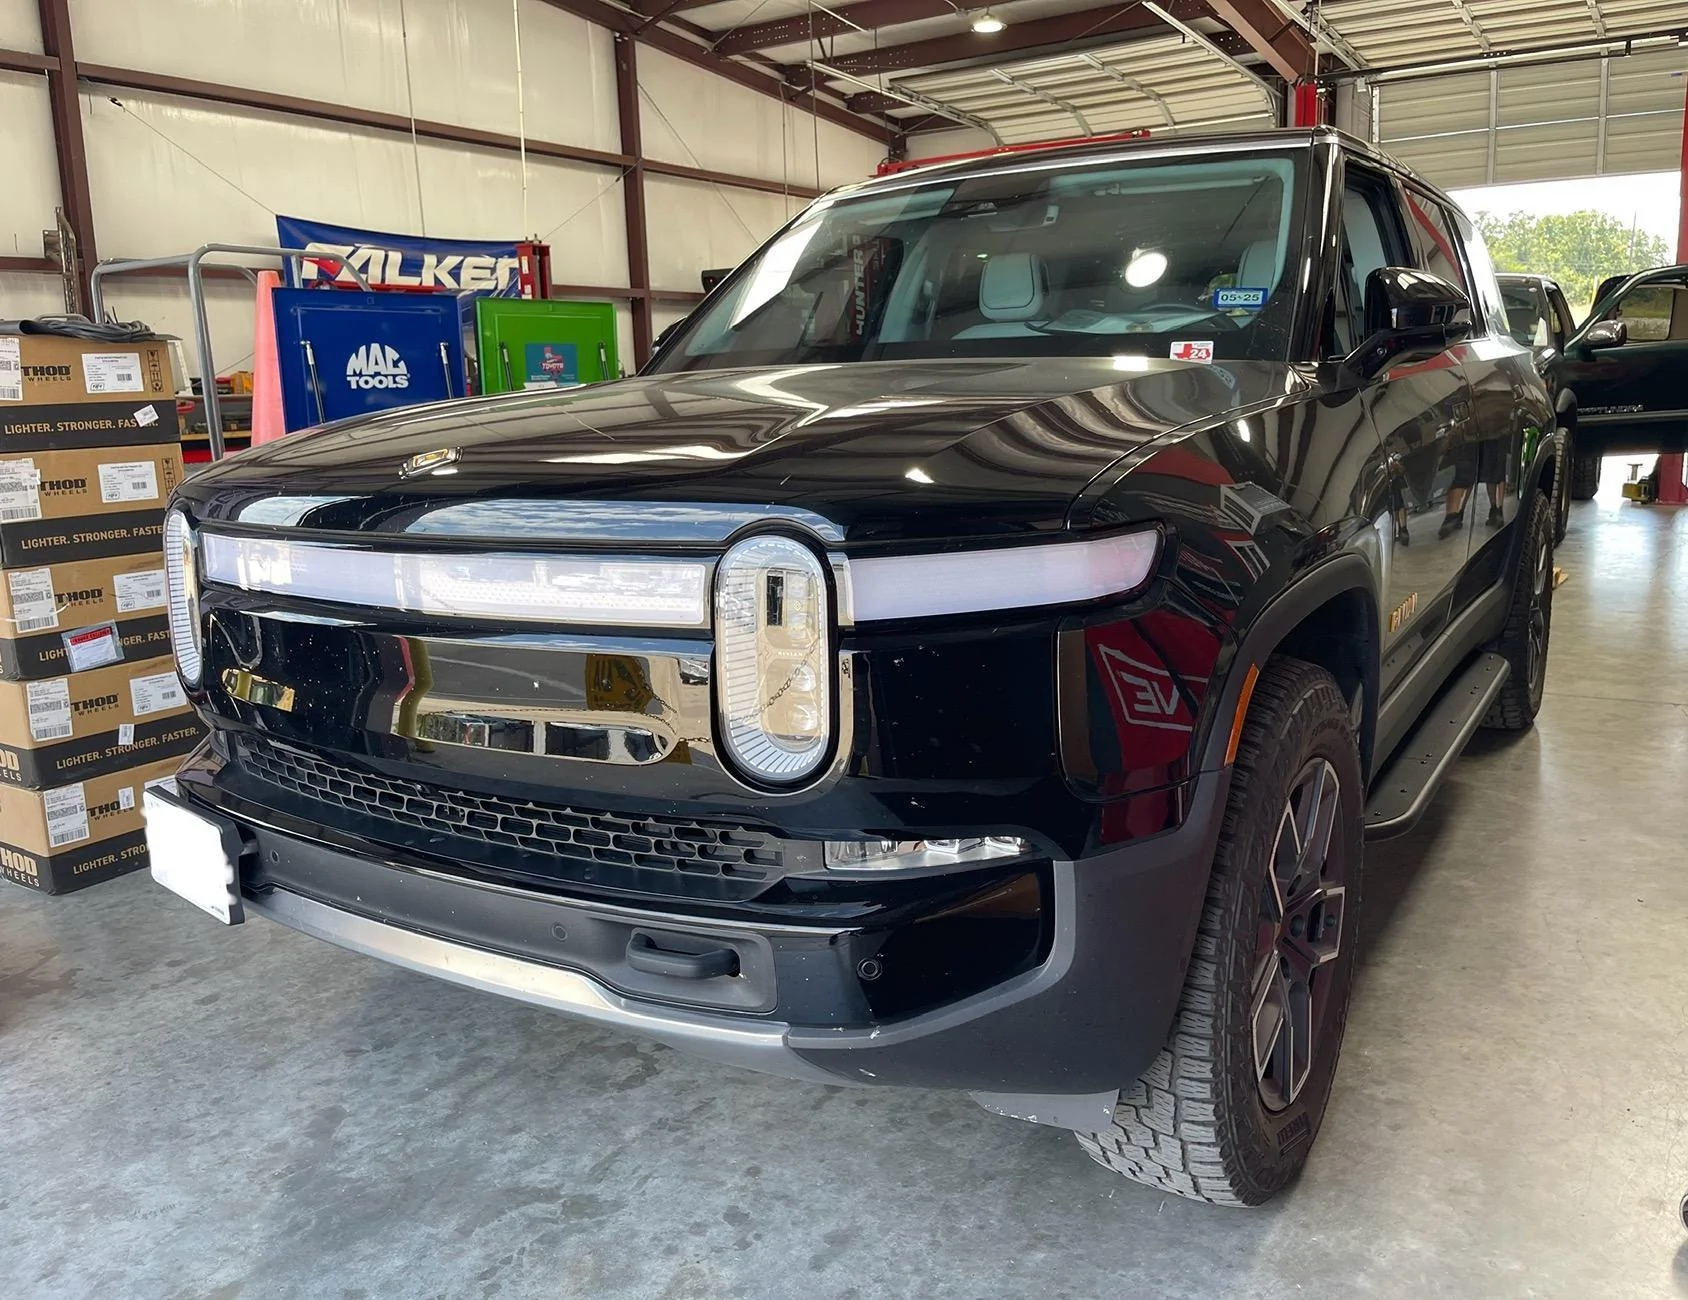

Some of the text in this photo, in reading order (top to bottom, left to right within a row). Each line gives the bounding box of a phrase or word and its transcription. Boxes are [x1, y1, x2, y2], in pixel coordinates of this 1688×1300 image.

[1220, 293, 1260, 302] 05 25
[346, 342, 408, 375] MAC
[1189, 348, 1208, 360] 24
[21, 365, 71, 376] THOD
[346, 375, 409, 390] TOOLS
[4, 421, 54, 435] LIGHTER.
[56, 419, 116, 432] STRONGER.
[40, 478, 87, 491] THOD
[44, 488, 88, 497] WHEELS
[21, 525, 163, 550] LIGHTER. STRONGER. FASTE
[54, 588, 103, 604] THOD
[148, 630, 171, 642] FAST
[70, 694, 118, 712] THOD
[78, 703, 120, 716] WHEELS
[56, 726, 200, 769] LIGHTER. STRONGER. FASTER.
[0, 847, 38, 877] HOD
[73, 854, 119, 875] LIGHTER.
